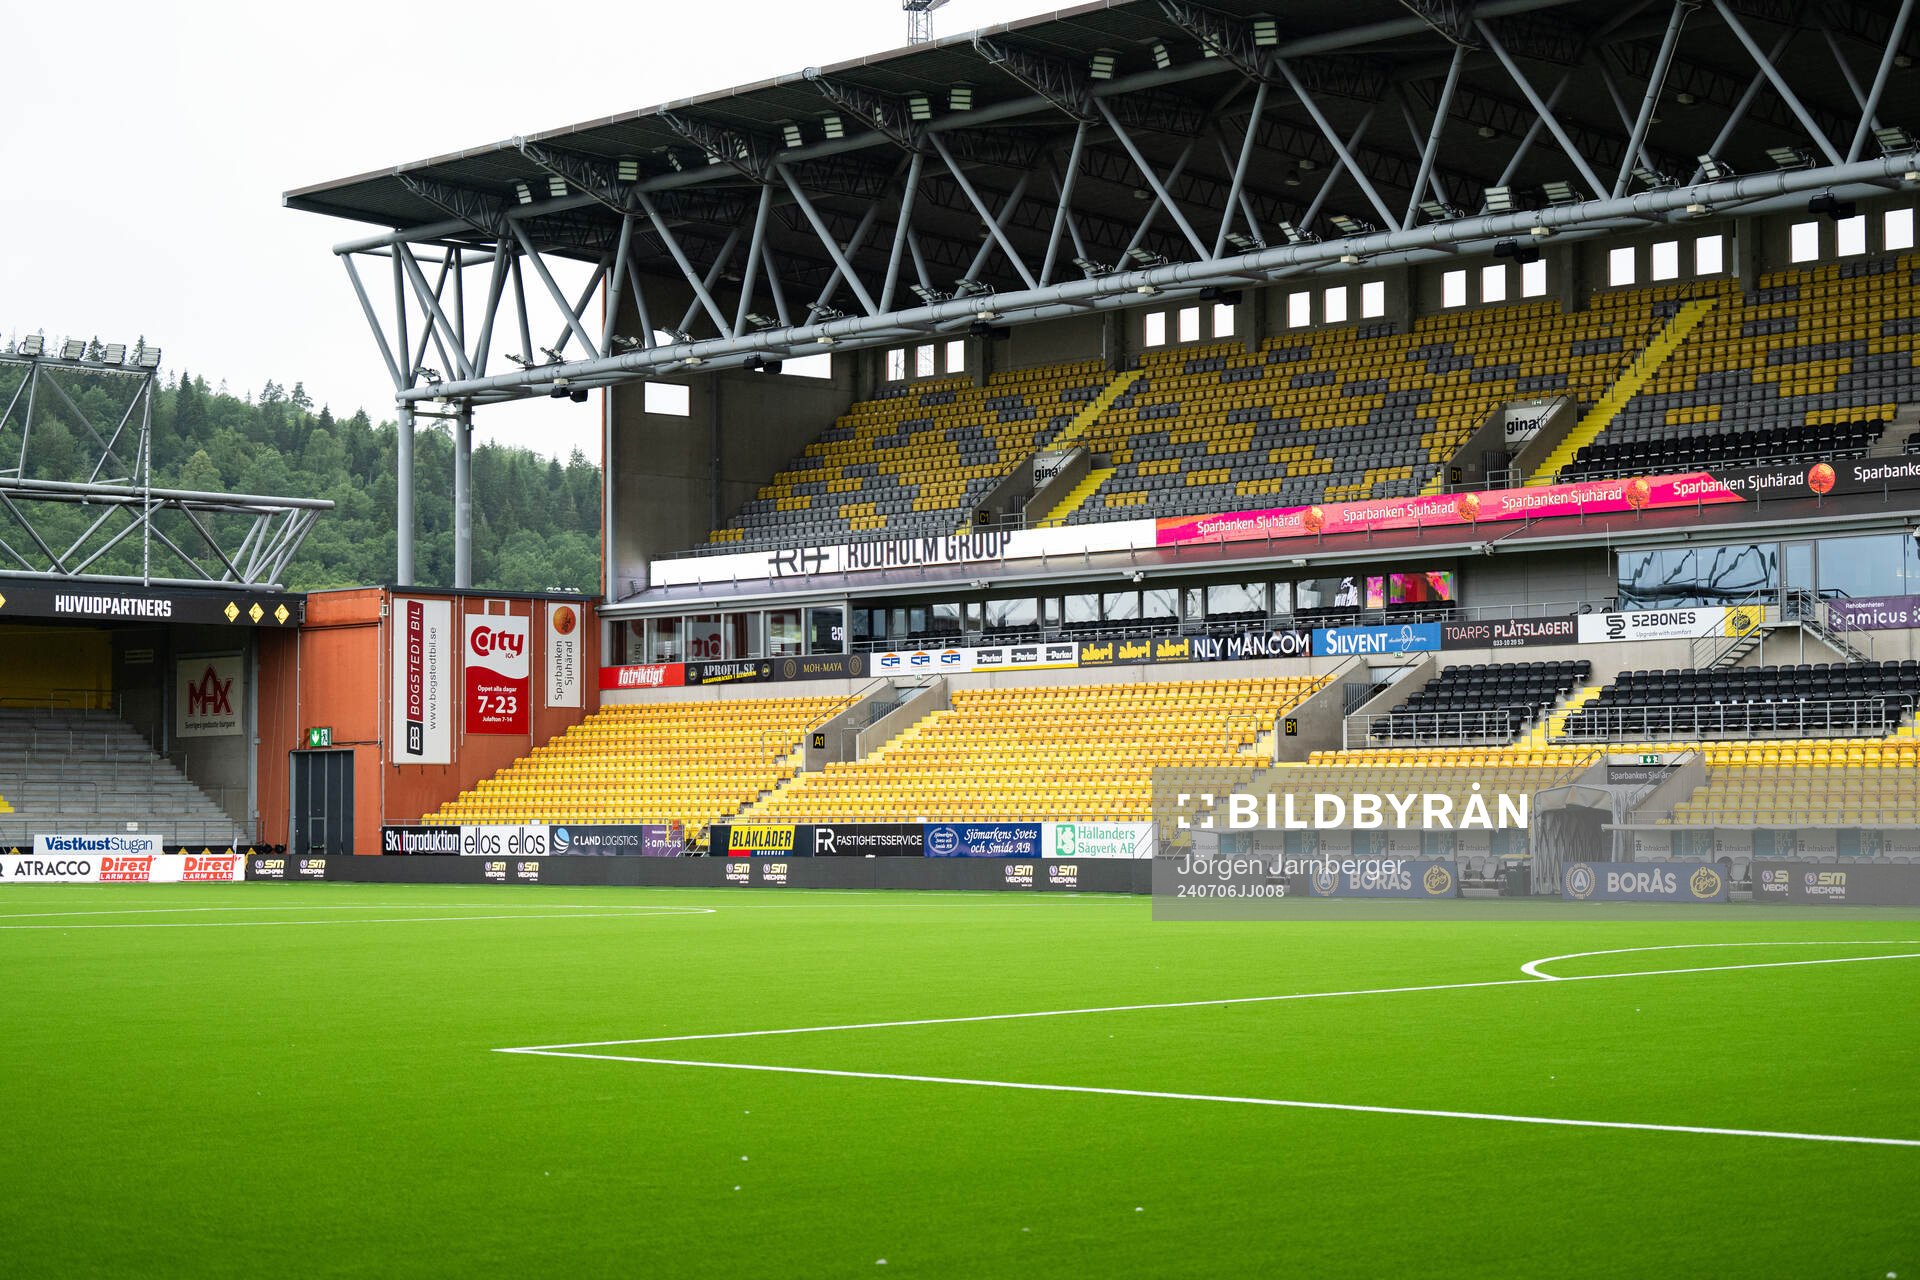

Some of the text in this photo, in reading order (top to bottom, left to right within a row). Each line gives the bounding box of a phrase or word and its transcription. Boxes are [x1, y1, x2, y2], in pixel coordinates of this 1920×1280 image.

[1673, 472, 1804, 497] Sparbanken Sjuhärad
[1502, 487, 1622, 511] Sparbanken Sjuhärad
[979, 512, 989, 523] C1
[1343, 501, 1455, 523] Sparbanken Sjuhärad
[1197, 514, 1300, 535] Sparbanken Sjuhärad
[848, 537, 938, 568] RUDHOLM
[945, 531, 1012, 561] GROUP
[55, 595, 172, 617] HUVUDPARTNERS
[410, 608, 420, 631] BIL
[1632, 612, 1696, 627] 52BONES
[1846, 609, 1908, 626] amicus
[1446, 625, 1490, 640] TOARPS
[1494, 619, 1574, 638] PLÅTSLAGERI
[470, 626, 524, 657] City
[1193, 633, 1310, 659] NLY MAN.COM
[1326, 629, 1388, 655] SILVENT
[981, 652, 1002, 663] Parker
[1016, 650, 1037, 662] Parker
[1051, 649, 1072, 660] Parker
[555, 640, 563, 701] Sparbanken
[565, 641, 574, 686] Sjuhärad
[803, 662, 842, 673] MOH-MAYA
[410, 634, 420, 715] BOGSTEDT
[187, 664, 234, 718] MAX
[477, 696, 518, 714] 7-23
[1286, 721, 1297, 733] B1
[814, 735, 824, 747] A1
[1611, 772, 1648, 781] Sparbanken
[385, 830, 459, 854] Skyltproduktion
[464, 827, 545, 855] ellos ellos
[580, 836, 601, 846] LAND
[602, 836, 639, 846] LOGISTICS
[732, 826, 792, 848] BLÅKLÄDER
[836, 835, 922, 847] FASTIGHETSSERVICE
[964, 827, 1038, 844] Sjömarkens Svets
[970, 841, 985, 853] och
[987, 842, 1014, 854] Smide
[1078, 842, 1135, 856] Sågverk AB
[15, 860, 91, 876] ATRACCO
[101, 855, 153, 872] Direct
[184, 855, 236, 871] Direct
[100, 872, 122, 880] LARM
[183, 872, 205, 880] LARM
[1607, 867, 1677, 894] BORÅS
[1817, 872, 1847, 885] SM
[1805, 886, 1846, 895] VECKAN
